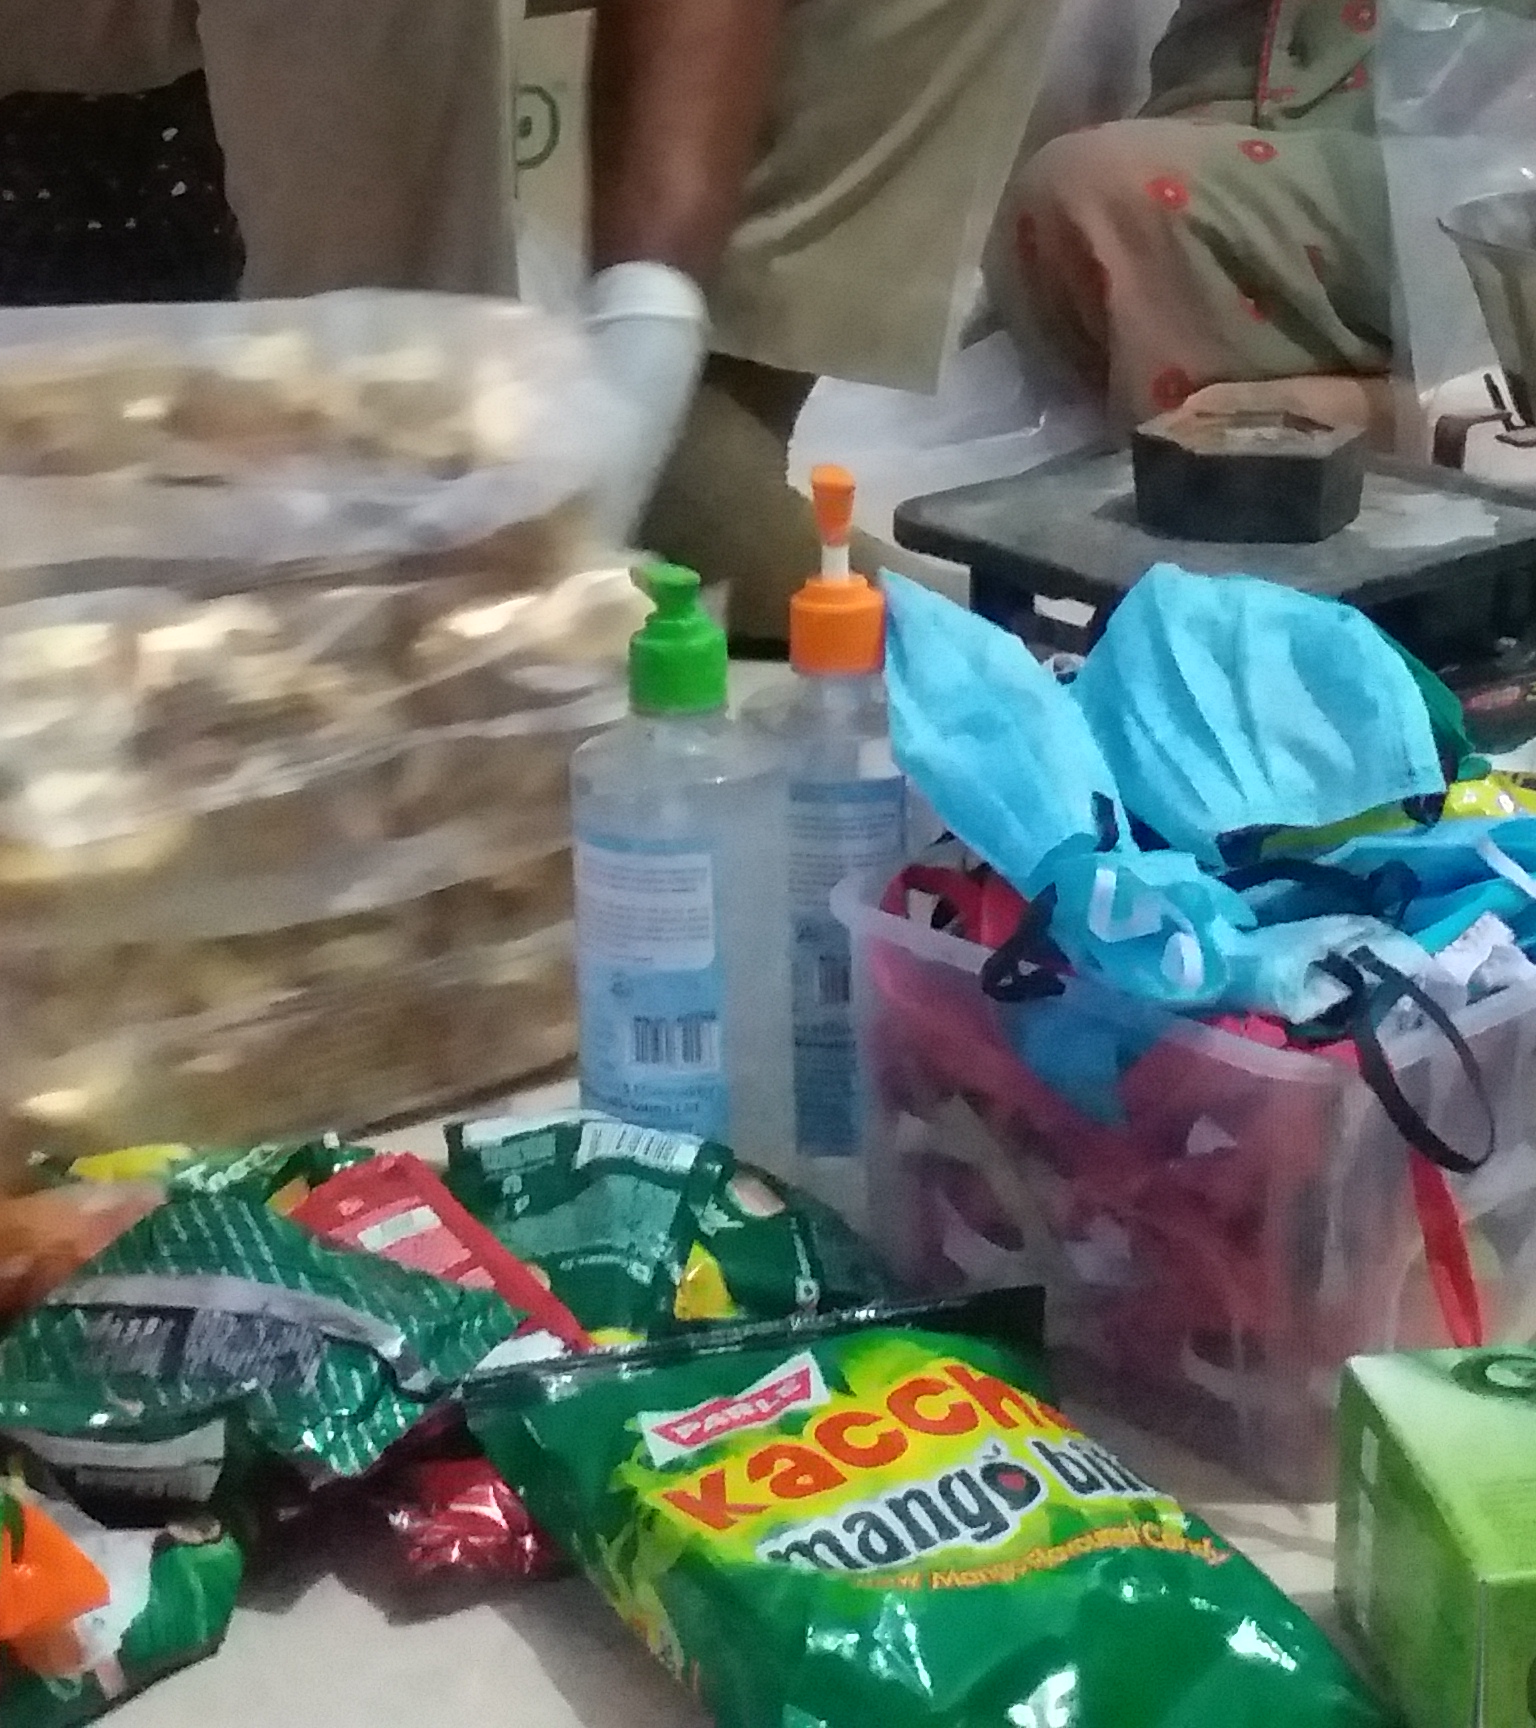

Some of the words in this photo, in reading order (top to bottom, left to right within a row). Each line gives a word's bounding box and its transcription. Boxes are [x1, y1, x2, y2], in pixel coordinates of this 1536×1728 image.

[670, 1377, 802, 1440] PARLE
[766, 1447, 1042, 1572] mango
[1031, 1440, 1160, 1495] bit
